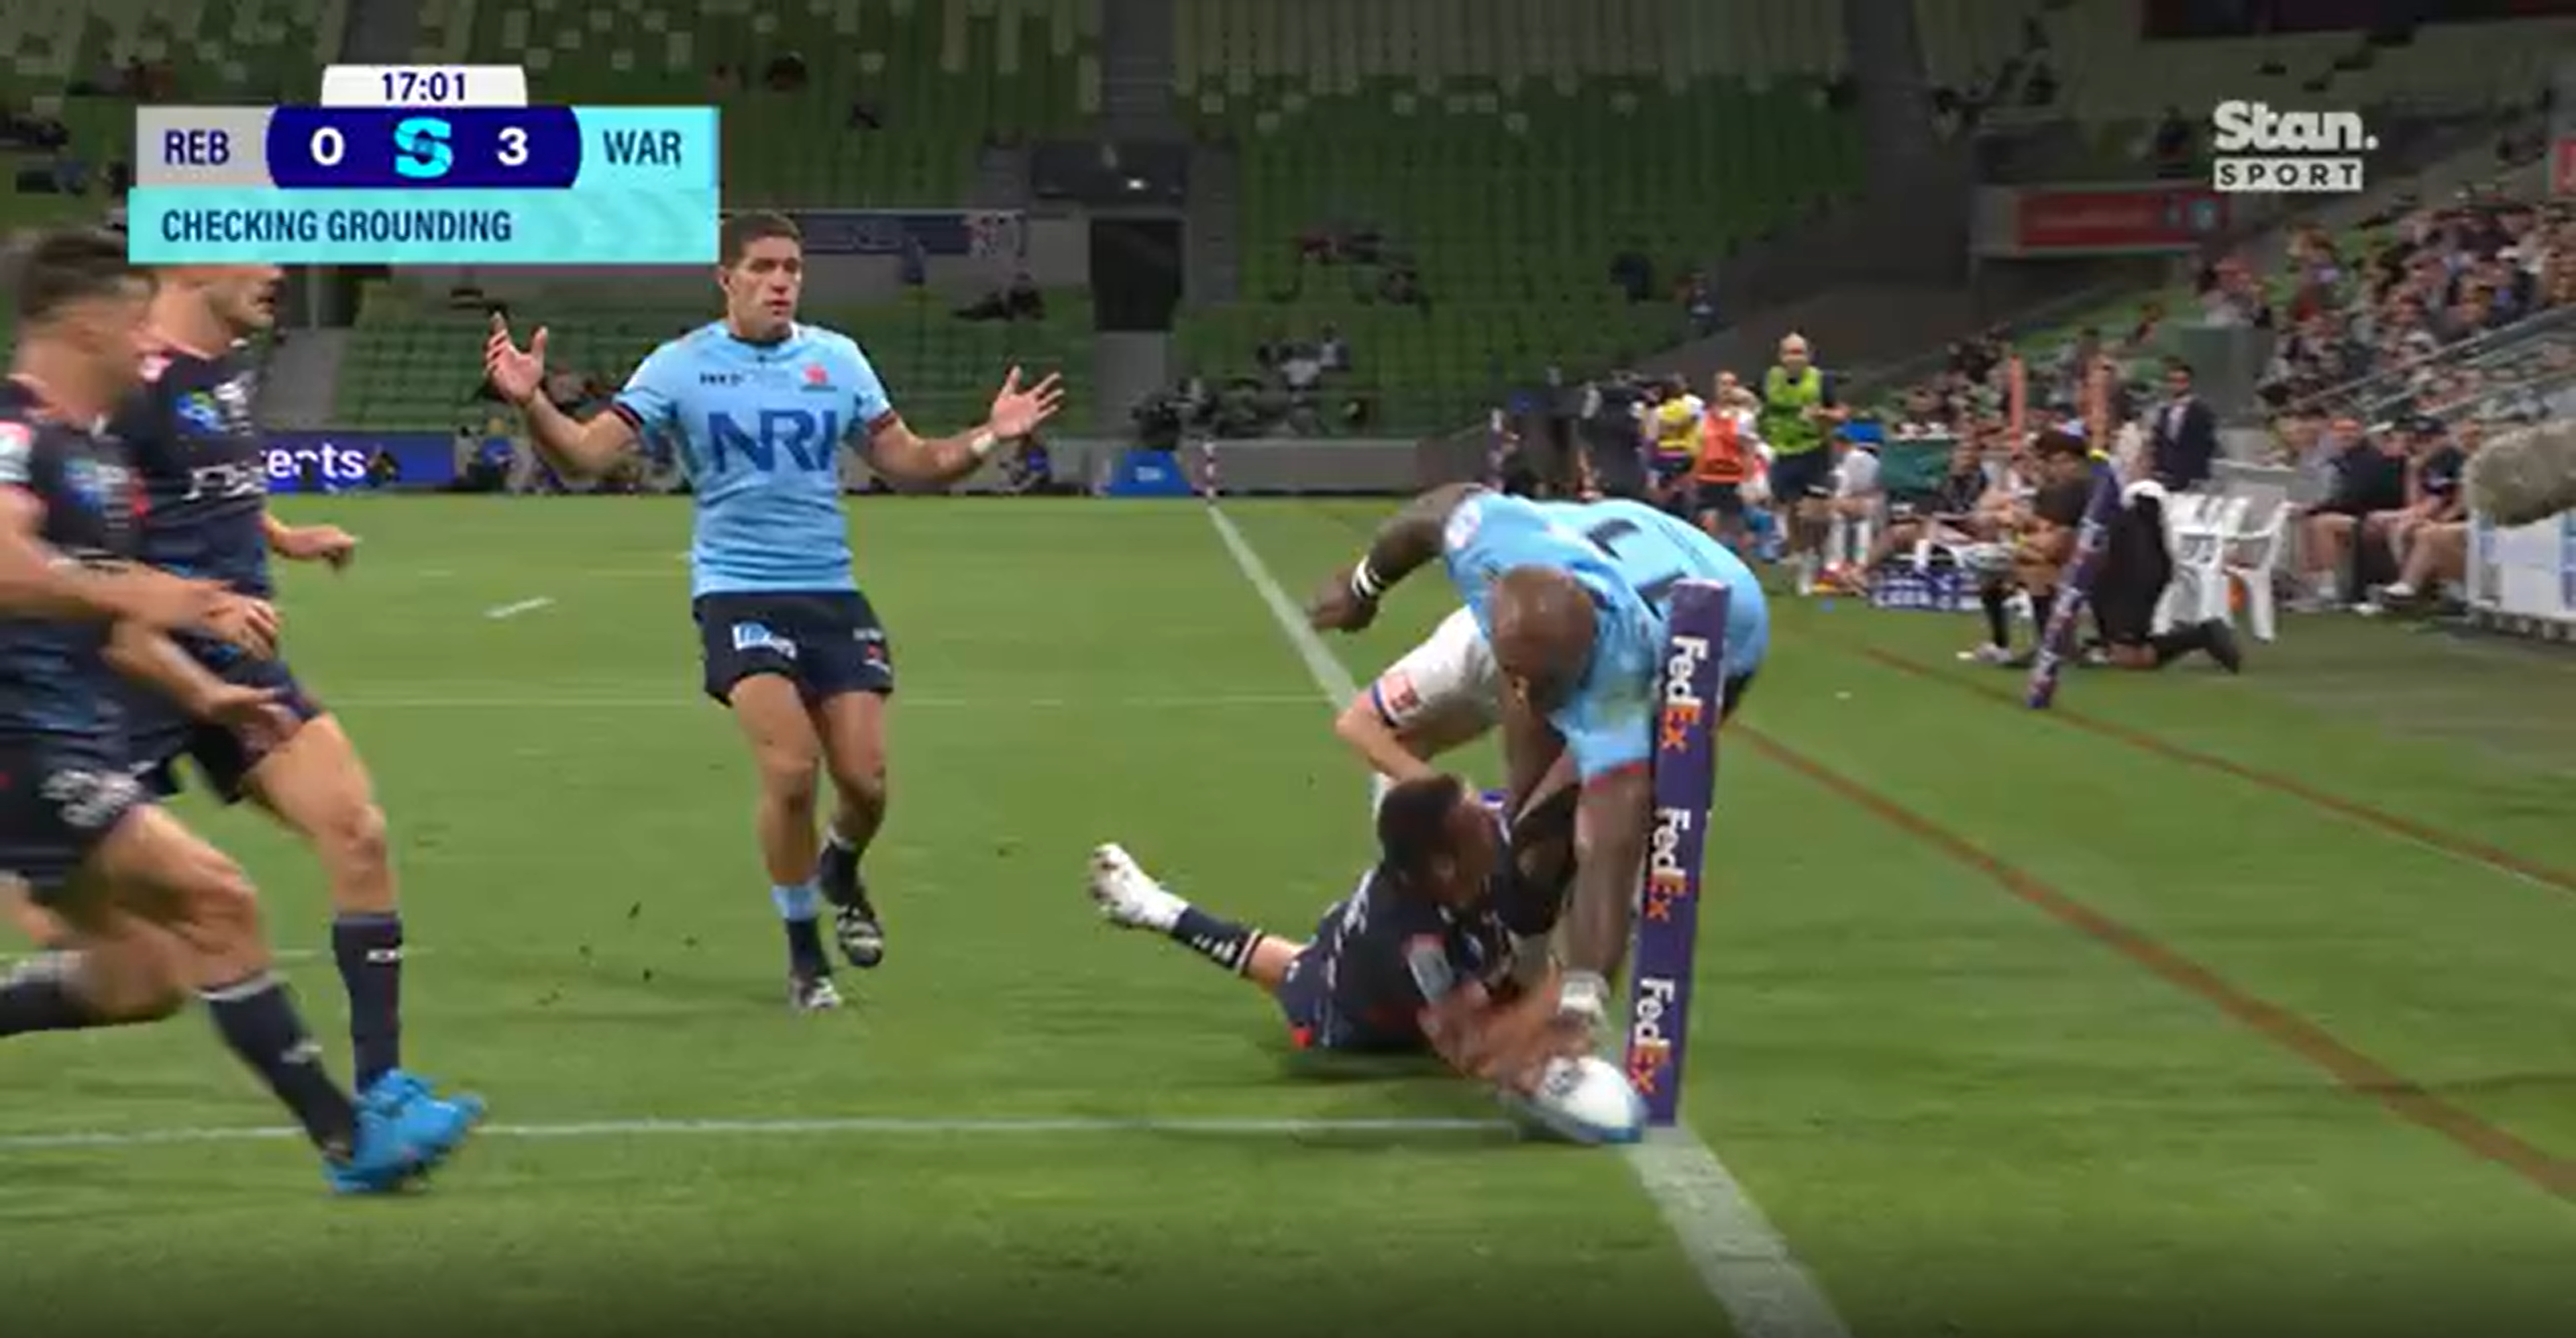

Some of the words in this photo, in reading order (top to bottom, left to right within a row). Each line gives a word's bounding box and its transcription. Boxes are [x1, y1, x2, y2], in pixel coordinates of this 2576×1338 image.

[1662, 635, 1709, 753] FedEx
[1646, 807, 1692, 922] FedEx
[1628, 977, 1675, 1094] FedEx
